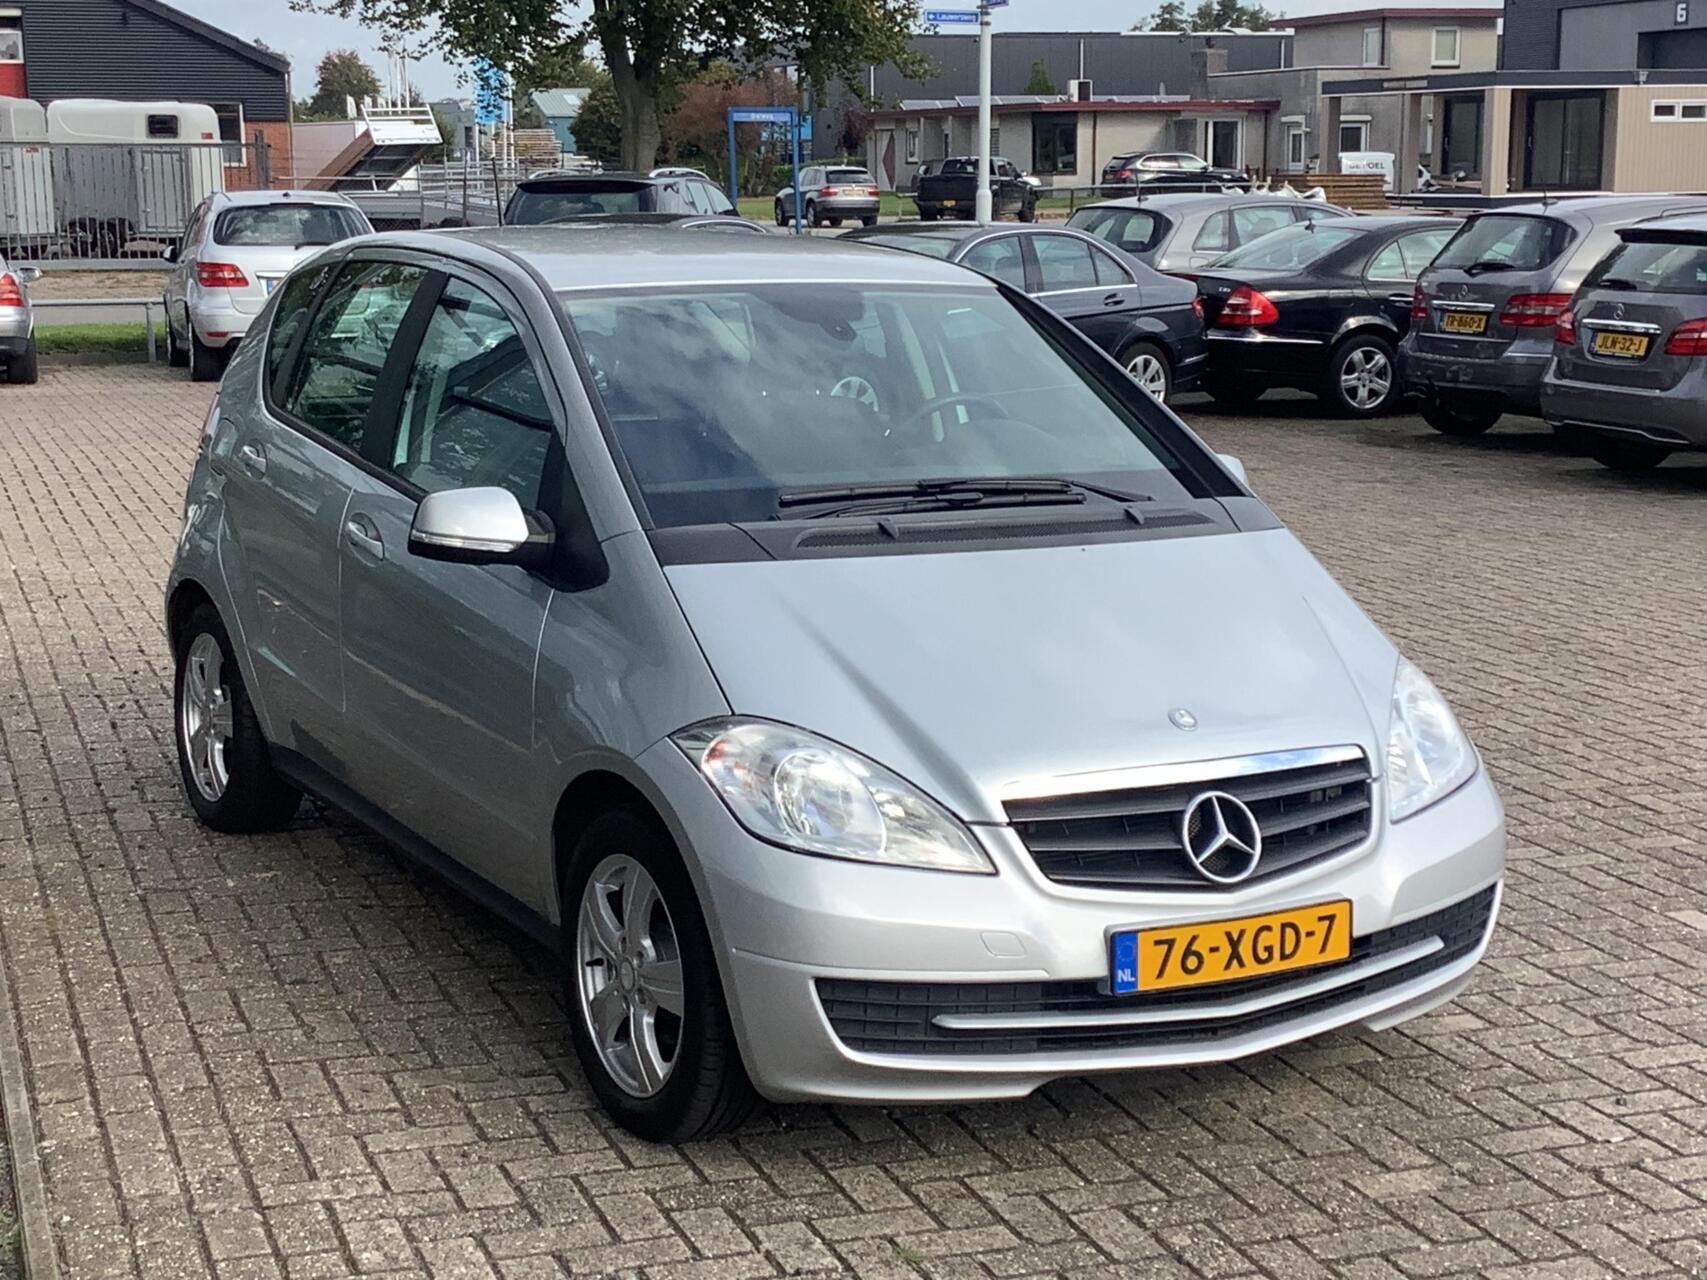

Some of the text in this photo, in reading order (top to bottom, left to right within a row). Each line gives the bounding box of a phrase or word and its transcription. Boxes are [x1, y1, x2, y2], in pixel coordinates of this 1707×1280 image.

[1676, 3, 1687, 22] 6
[1597, 335, 1643, 353] JLN-32-J
[1153, 913, 1338, 980] 76-XGD-7
[1117, 968, 1136, 983] NL
